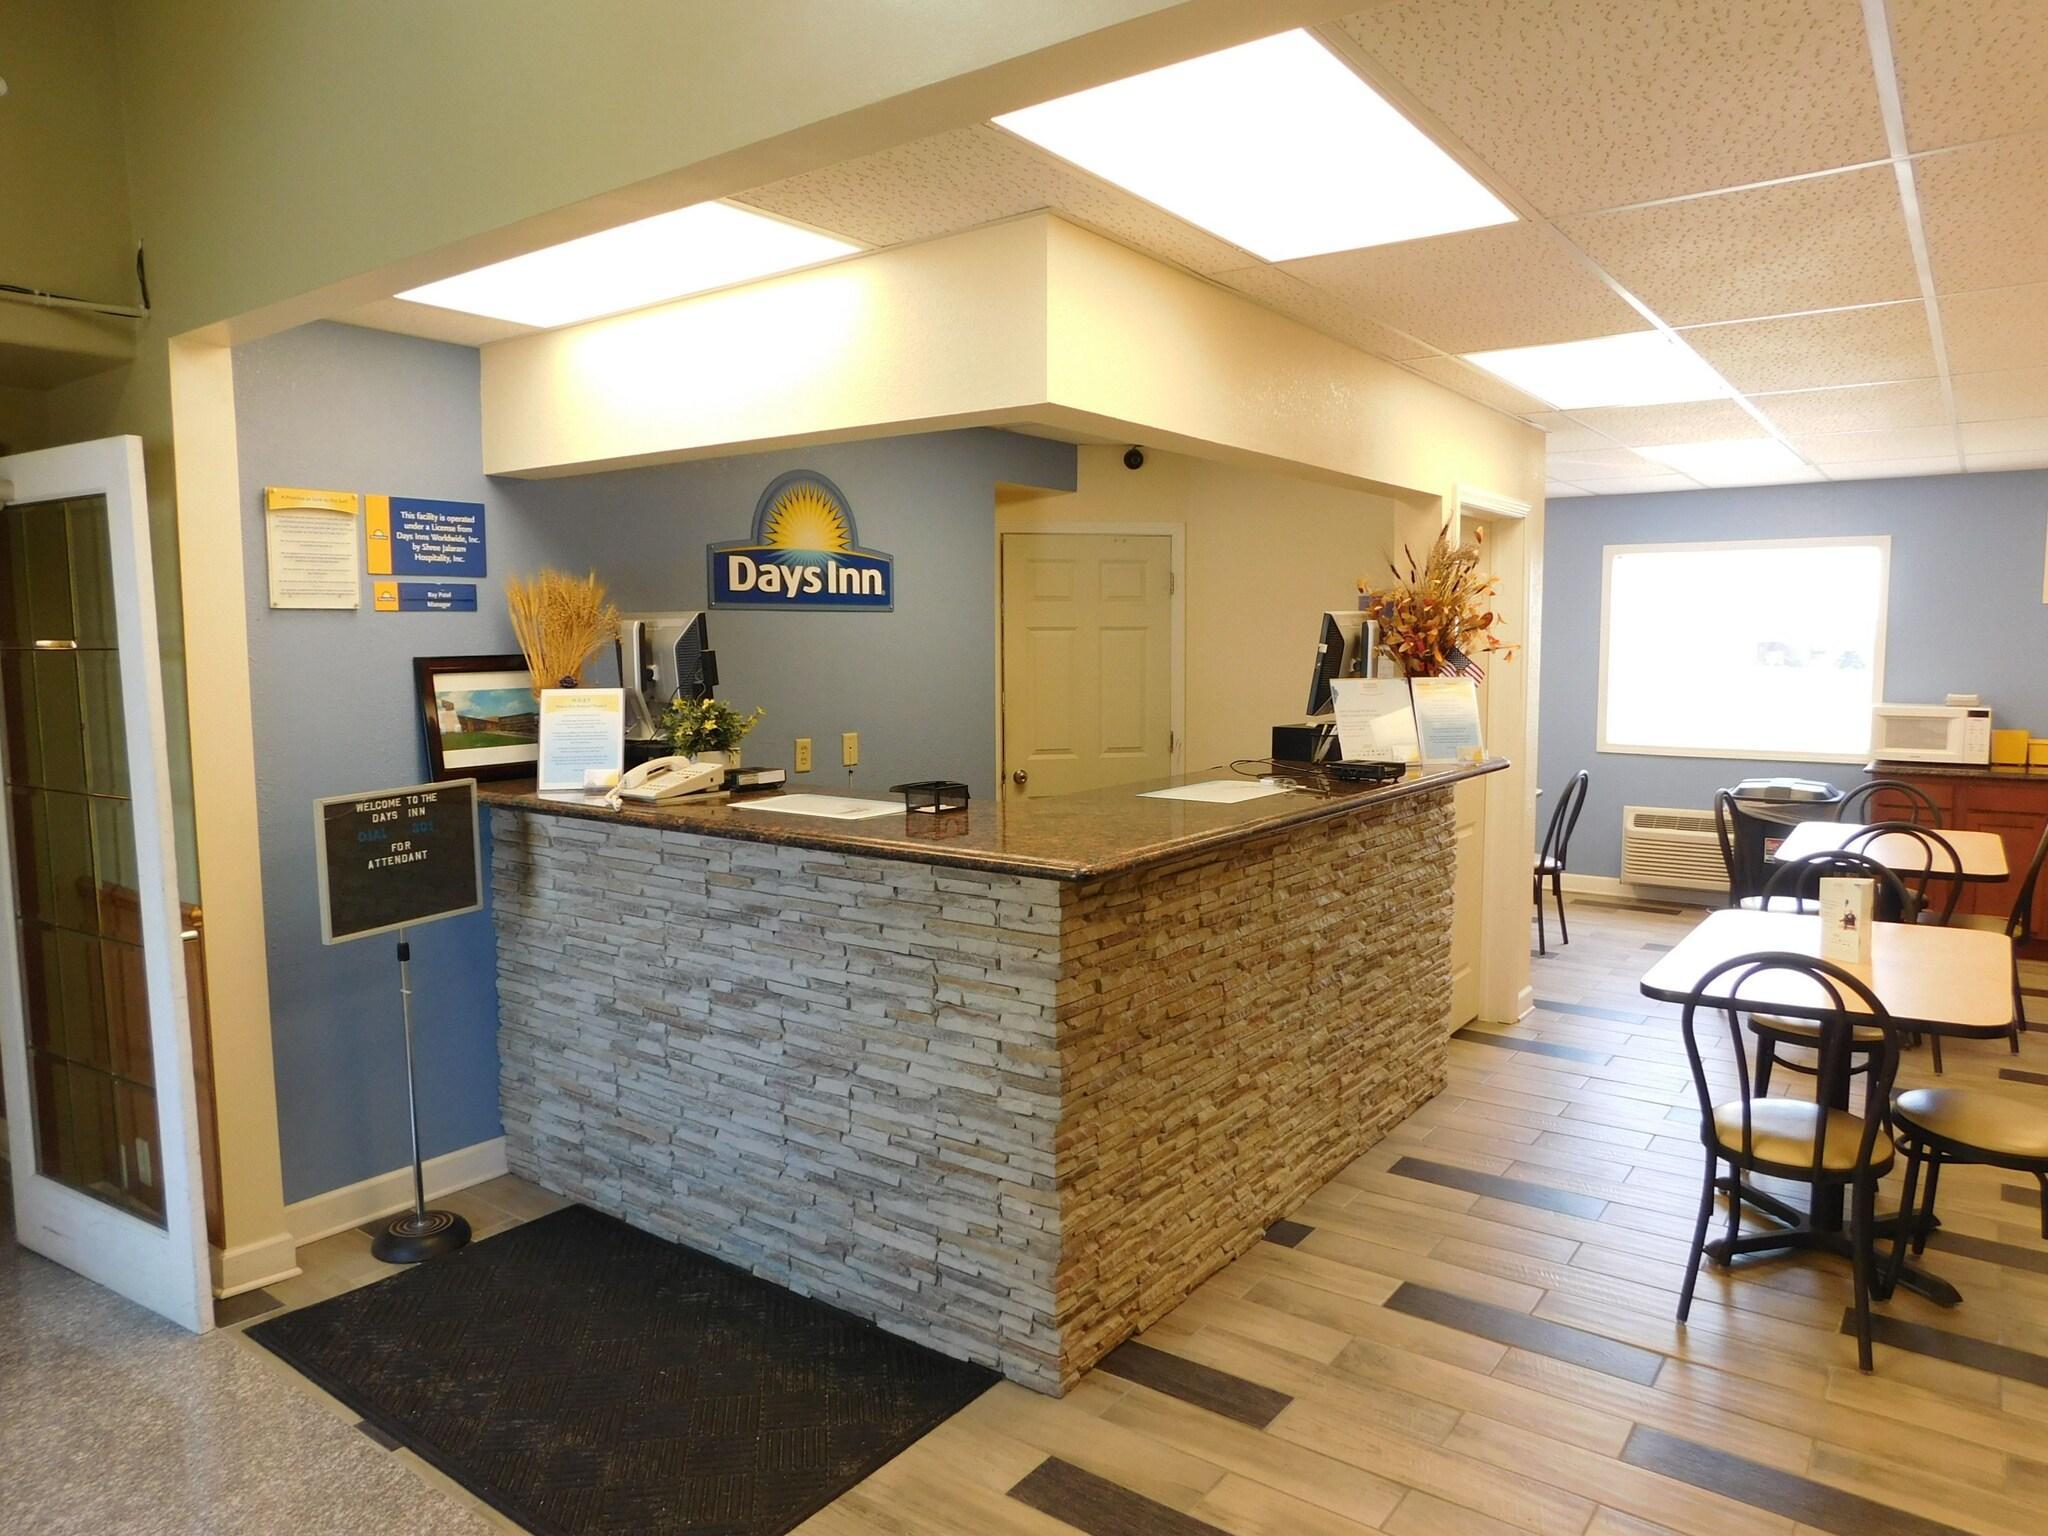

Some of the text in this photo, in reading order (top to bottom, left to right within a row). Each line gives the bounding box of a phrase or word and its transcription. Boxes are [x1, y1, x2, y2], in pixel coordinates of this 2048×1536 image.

[400, 511, 475, 524] This facility is operated
[404, 522, 424, 530] under
[431, 523, 456, 532] License
[457, 525, 473, 533] from
[396, 531, 414, 541] Days
[415, 533, 430, 541] Inns
[412, 542, 420, 552] by
[728, 555, 883, 598] Days Inn
[356, 793, 437, 813] WELCOME TO THE
[372, 807, 425, 823] DAYS INN
[391, 841, 411, 852] FOR
[368, 850, 428, 870] ATTENDANT
